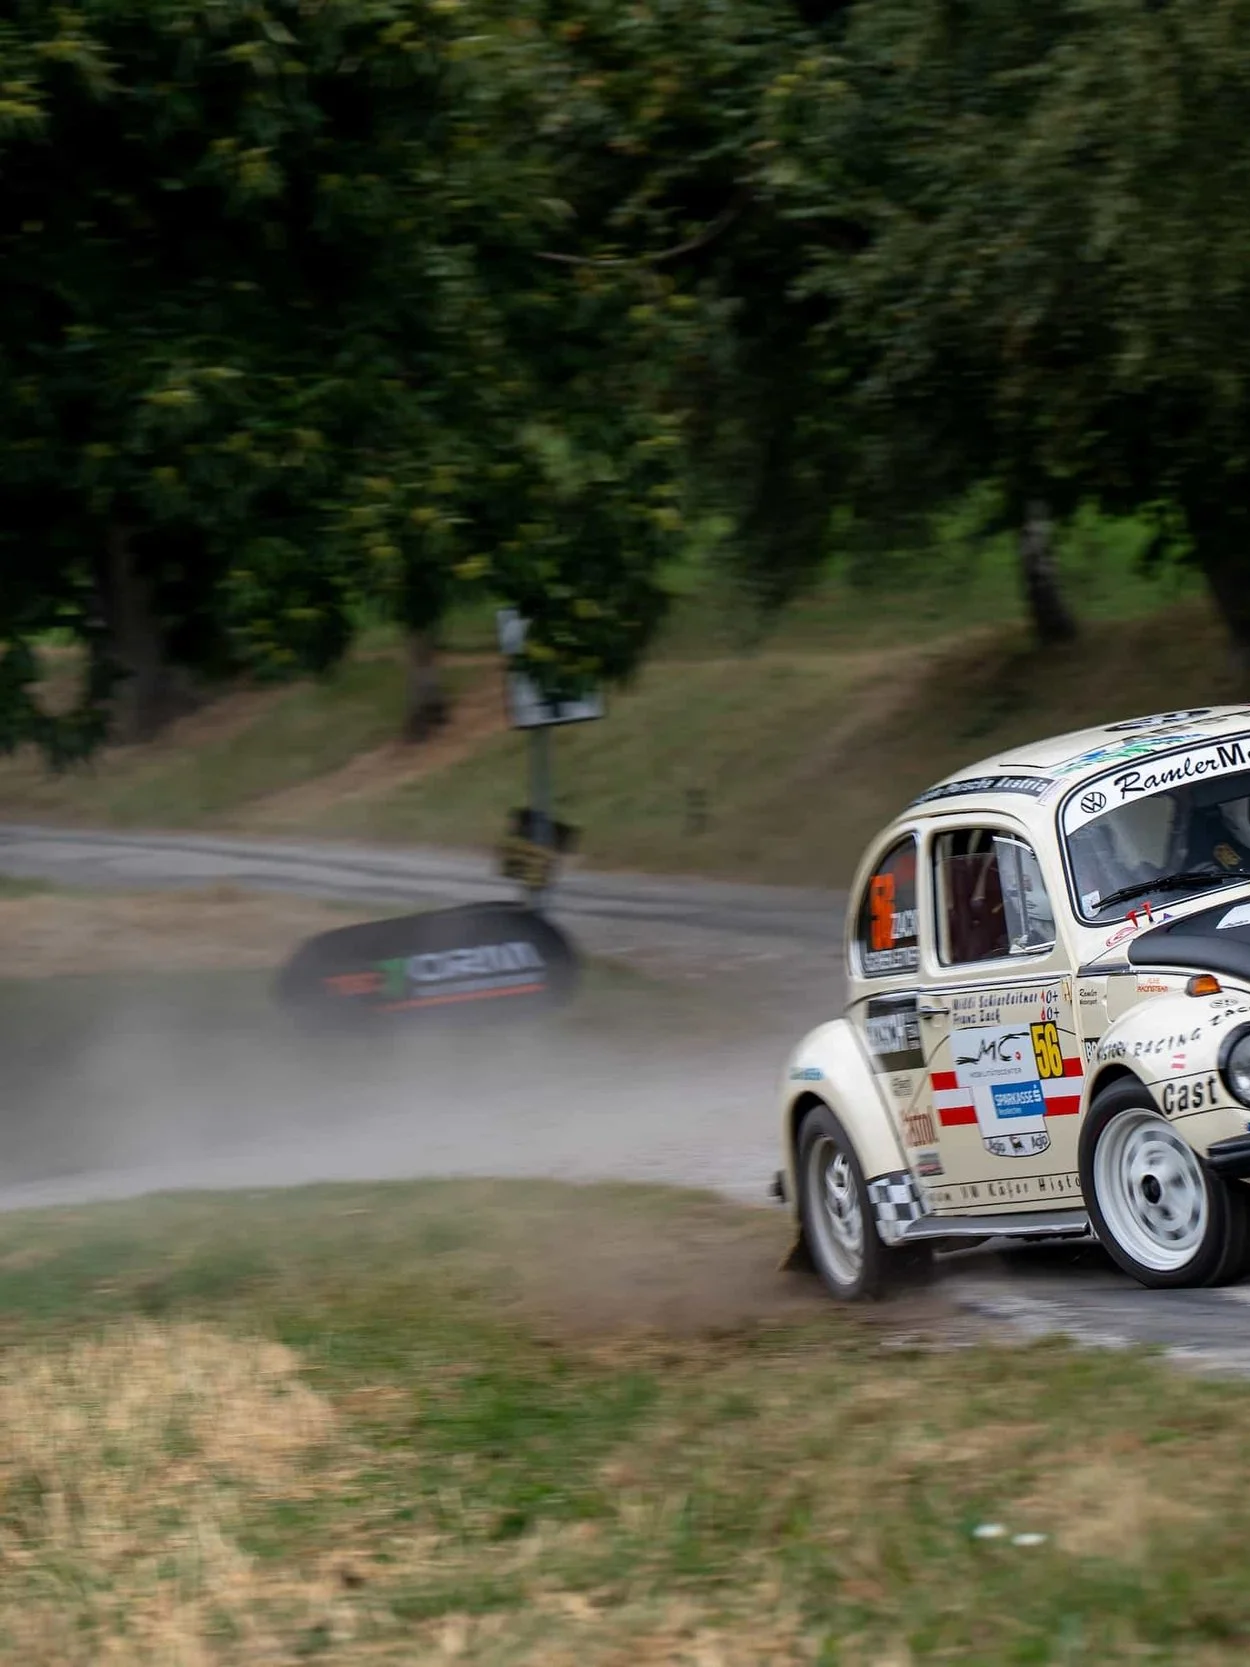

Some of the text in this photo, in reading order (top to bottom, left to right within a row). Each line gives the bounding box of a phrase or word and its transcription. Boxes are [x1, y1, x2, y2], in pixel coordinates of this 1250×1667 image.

[995, 776, 1048, 793] Austria
[1114, 756, 1220, 800] Ramler
[1031, 1022, 1063, 1078] 56
[994, 1091, 1035, 1107] SPARKASSE
